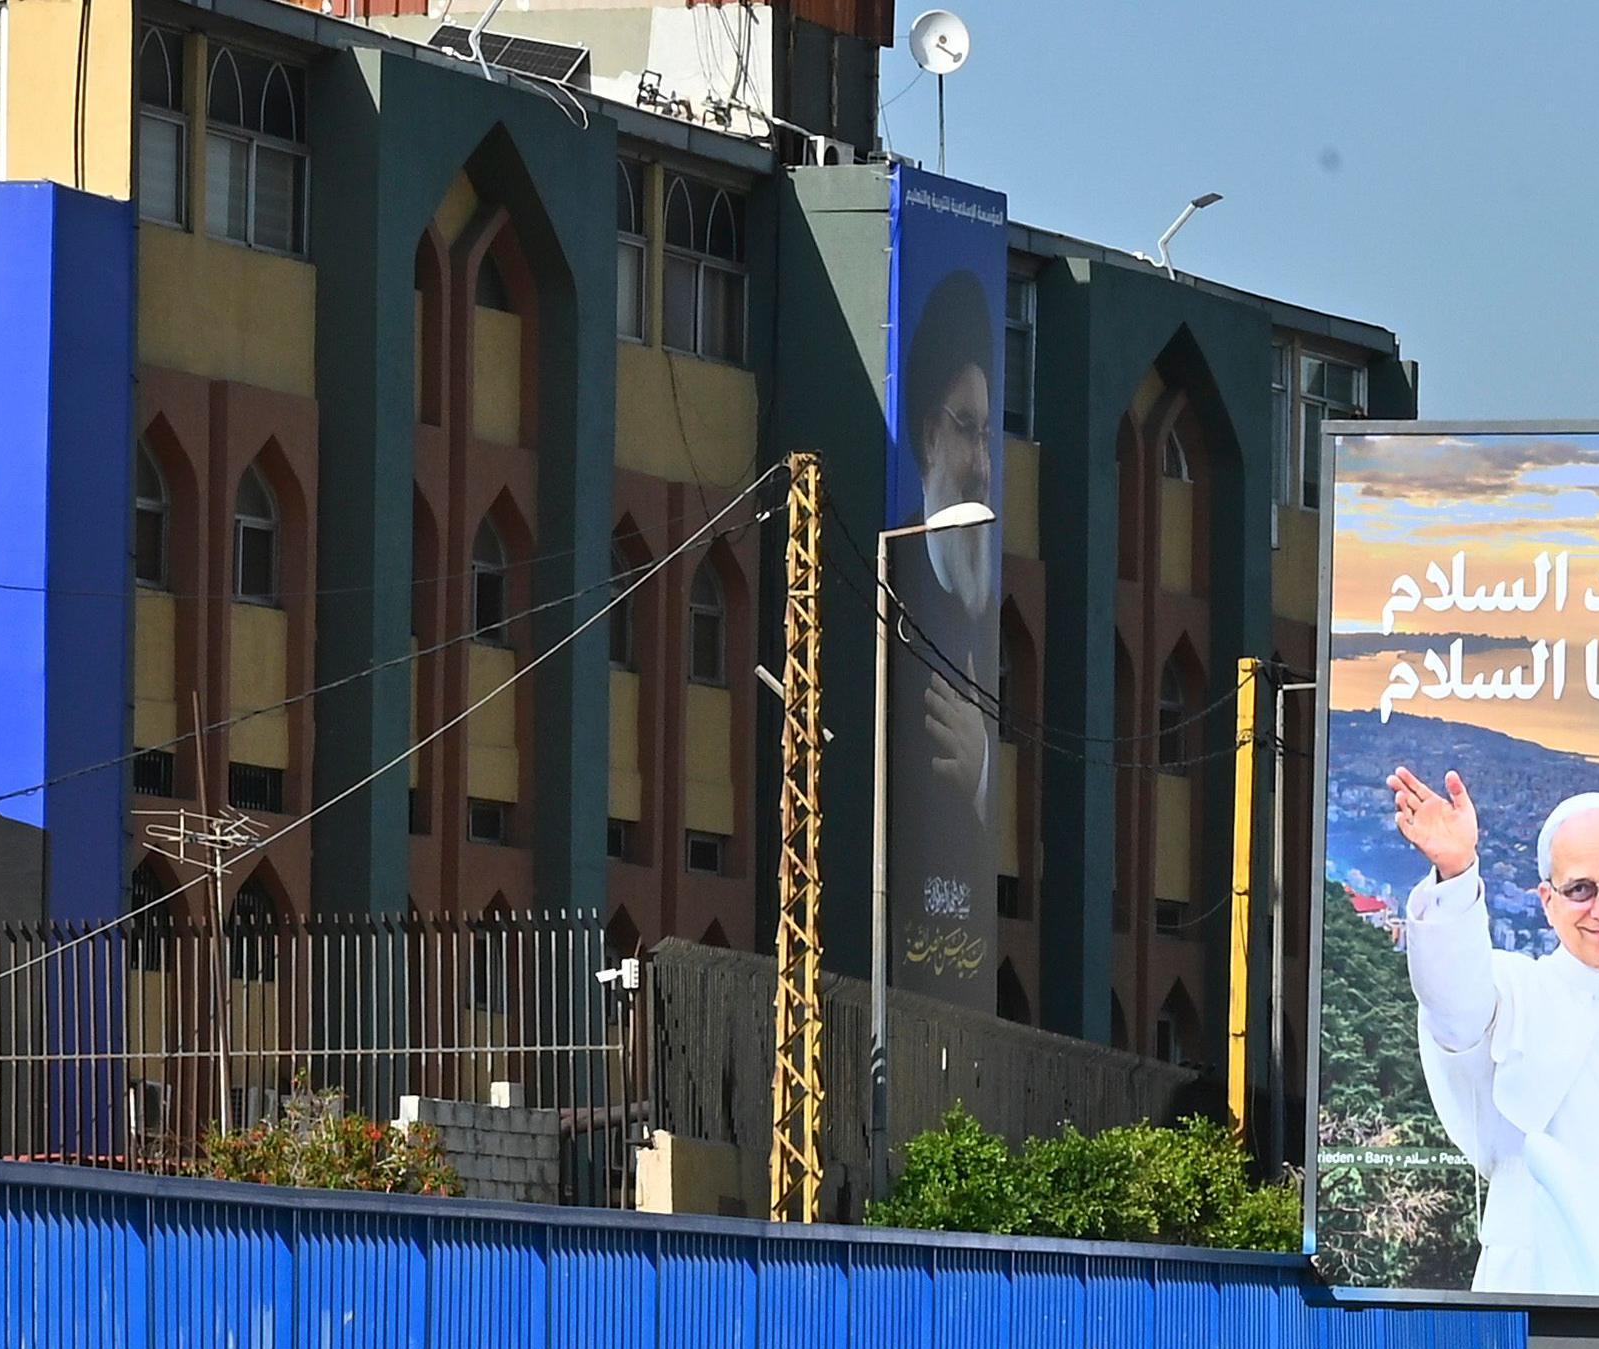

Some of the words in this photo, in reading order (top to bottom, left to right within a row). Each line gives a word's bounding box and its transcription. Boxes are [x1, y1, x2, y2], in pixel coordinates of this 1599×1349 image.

[1380, 550, 1570, 636] السلام
[1379, 638, 1567, 725] السلام
[1317, 1151, 1355, 1165] rieden
[1439, 1151, 1473, 1165] Peac
